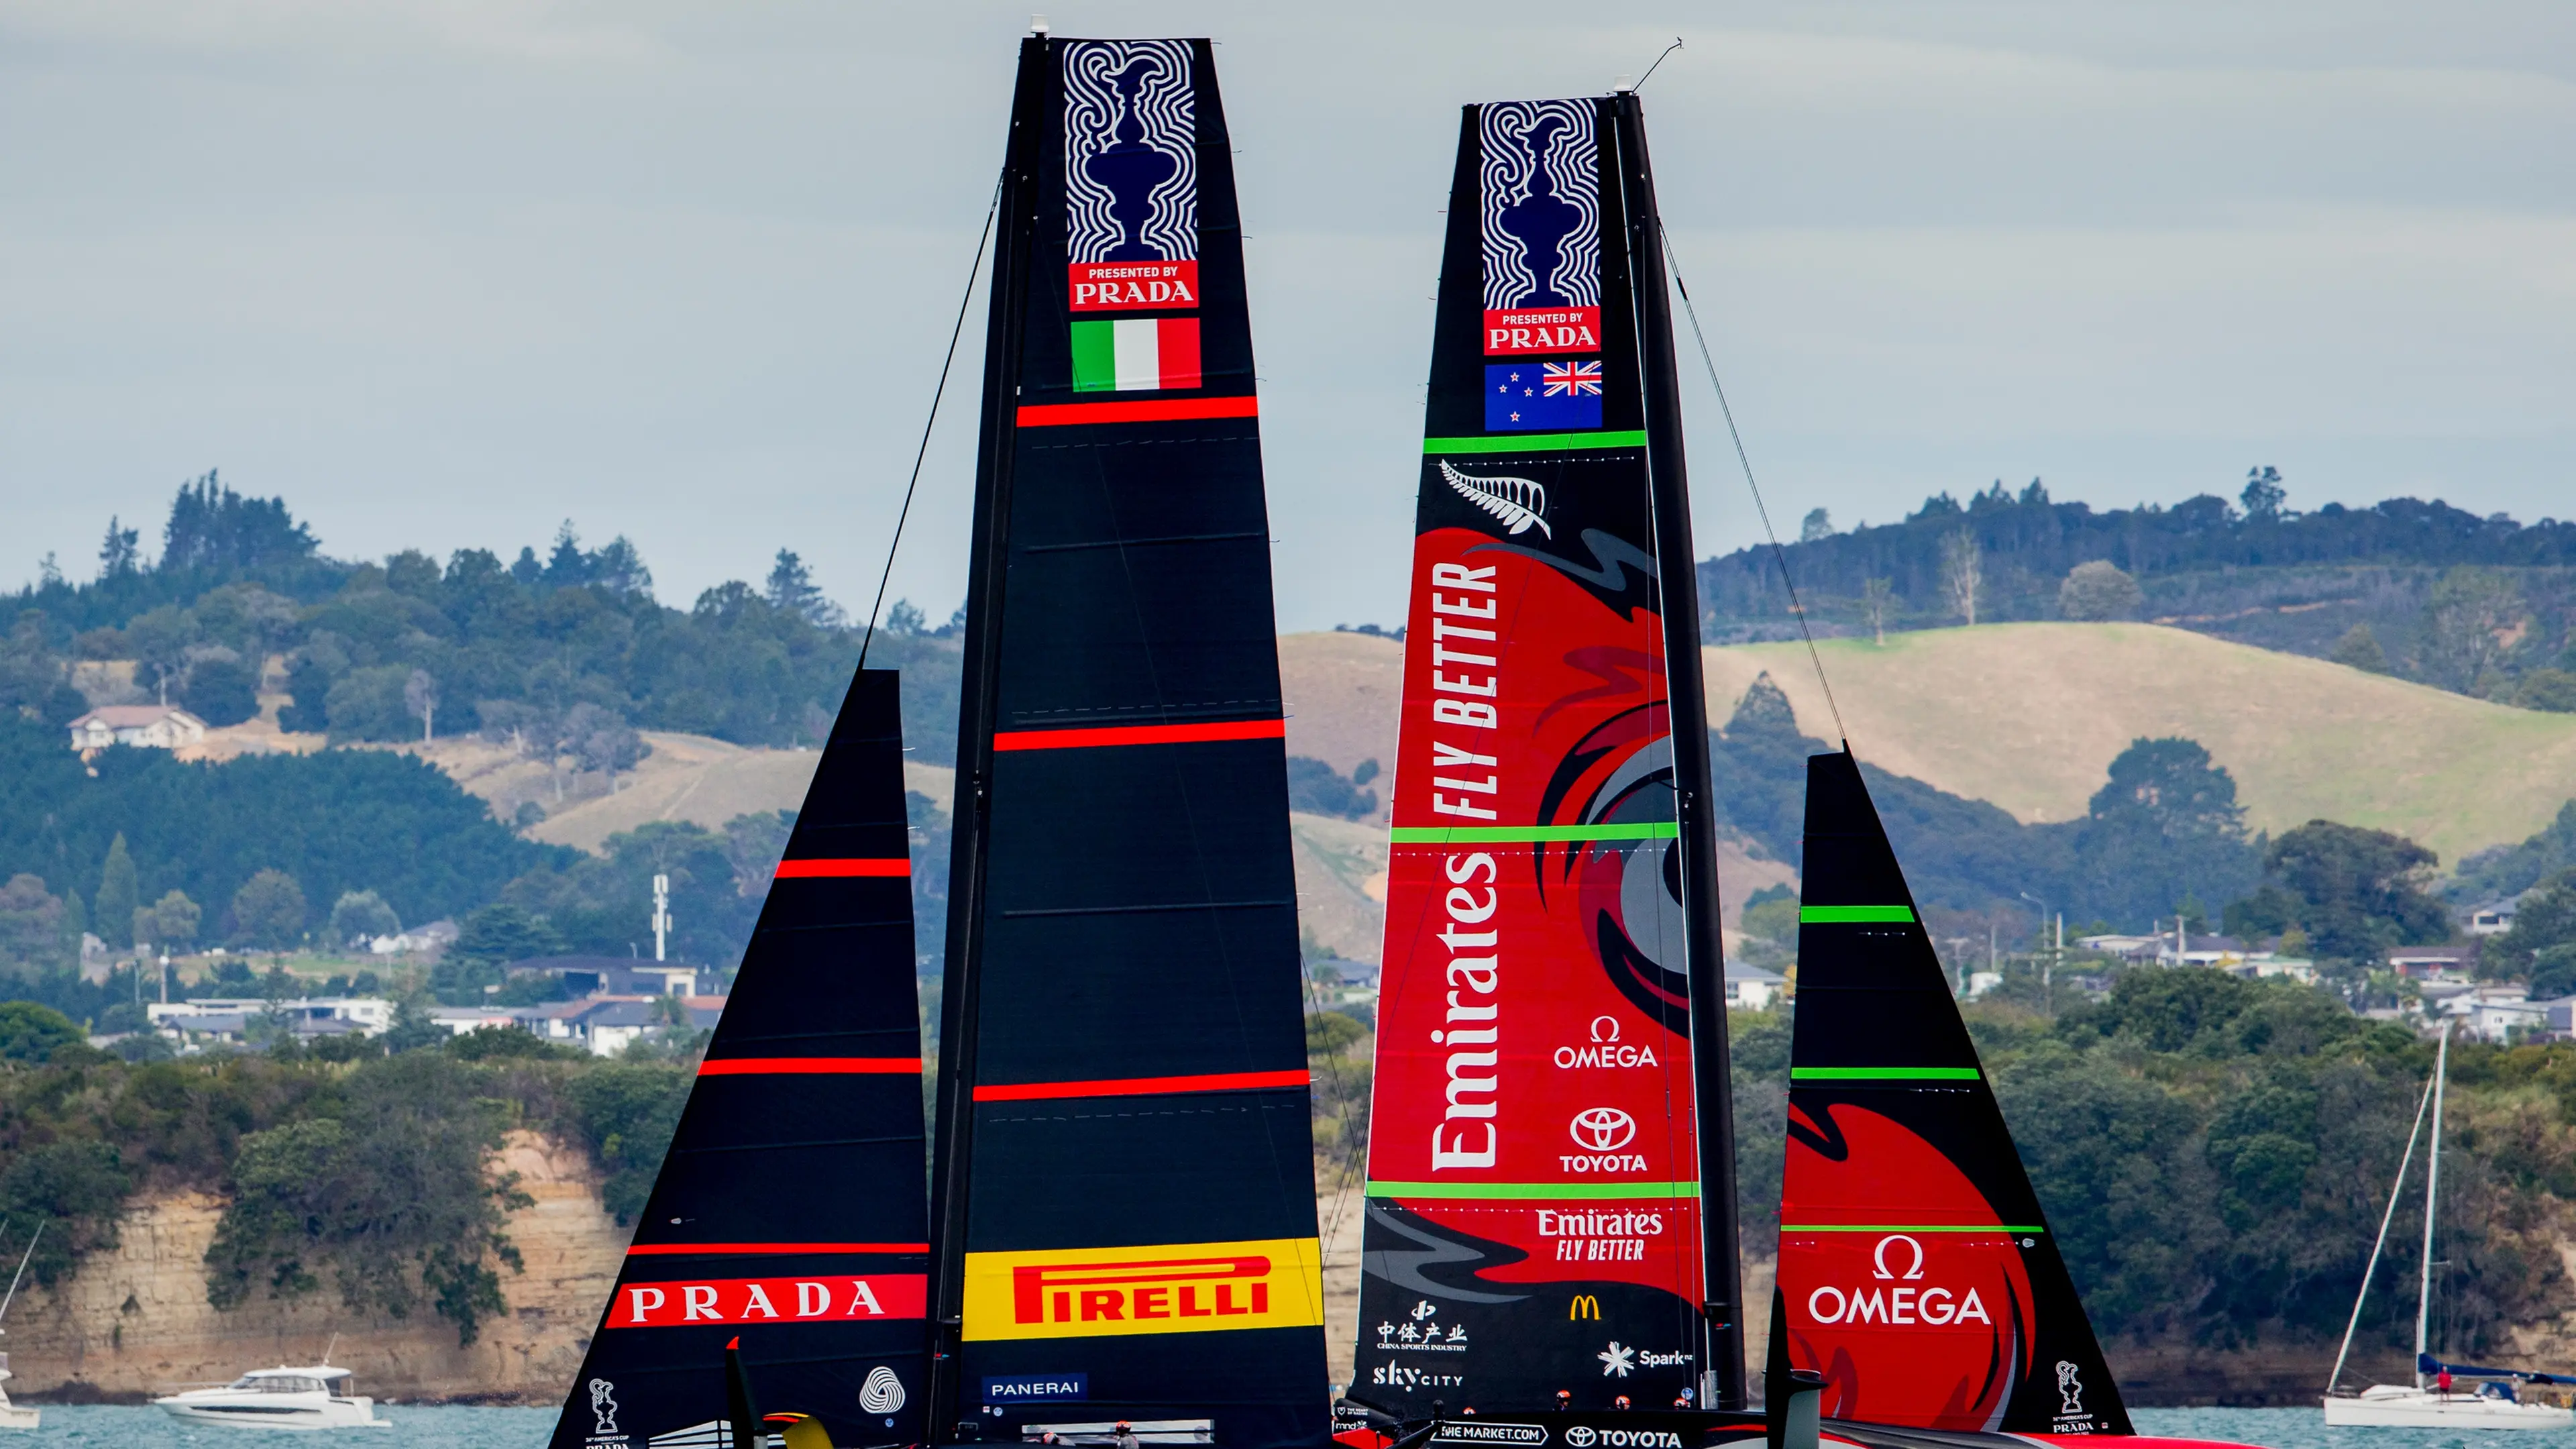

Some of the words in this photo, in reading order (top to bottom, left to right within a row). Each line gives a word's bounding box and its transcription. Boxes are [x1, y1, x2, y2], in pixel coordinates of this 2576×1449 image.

[1089, 267, 1159, 279] PRESENTED
[1163, 266, 1178, 277] BY
[1075, 280, 1194, 305] PRADA
[1503, 314, 1564, 325] PRESENTED
[1568, 313, 1583, 323] BY
[1489, 326, 1597, 349] PRADA
[1432, 562, 1497, 729] BETTER
[1433, 741, 1497, 820] FLY
[1430, 852, 1498, 1172] Emirates
[1554, 1044, 1658, 1069] OMEGA
[1559, 1155, 1648, 1173] TOYOTA
[1536, 1208, 1663, 1236] Emirates
[1556, 1239, 1584, 1260] FLY
[1587, 1239, 1644, 1260] BETTER
[1012, 1255, 1271, 1324] PIRELLI
[629, 1281, 885, 1322] PRADA
[1809, 1286, 1991, 1325] OMEGA
[1377, 1320, 1468, 1344] 中体产业
[1640, 1350, 1684, 1368] Spark
[991, 1382, 1078, 1396] PANERAI
[1463, 1426, 1540, 1440] MARKET.COM
[1599, 1430, 1682, 1448] TOYOTA
[2053, 1422, 2094, 1433] PRADA
